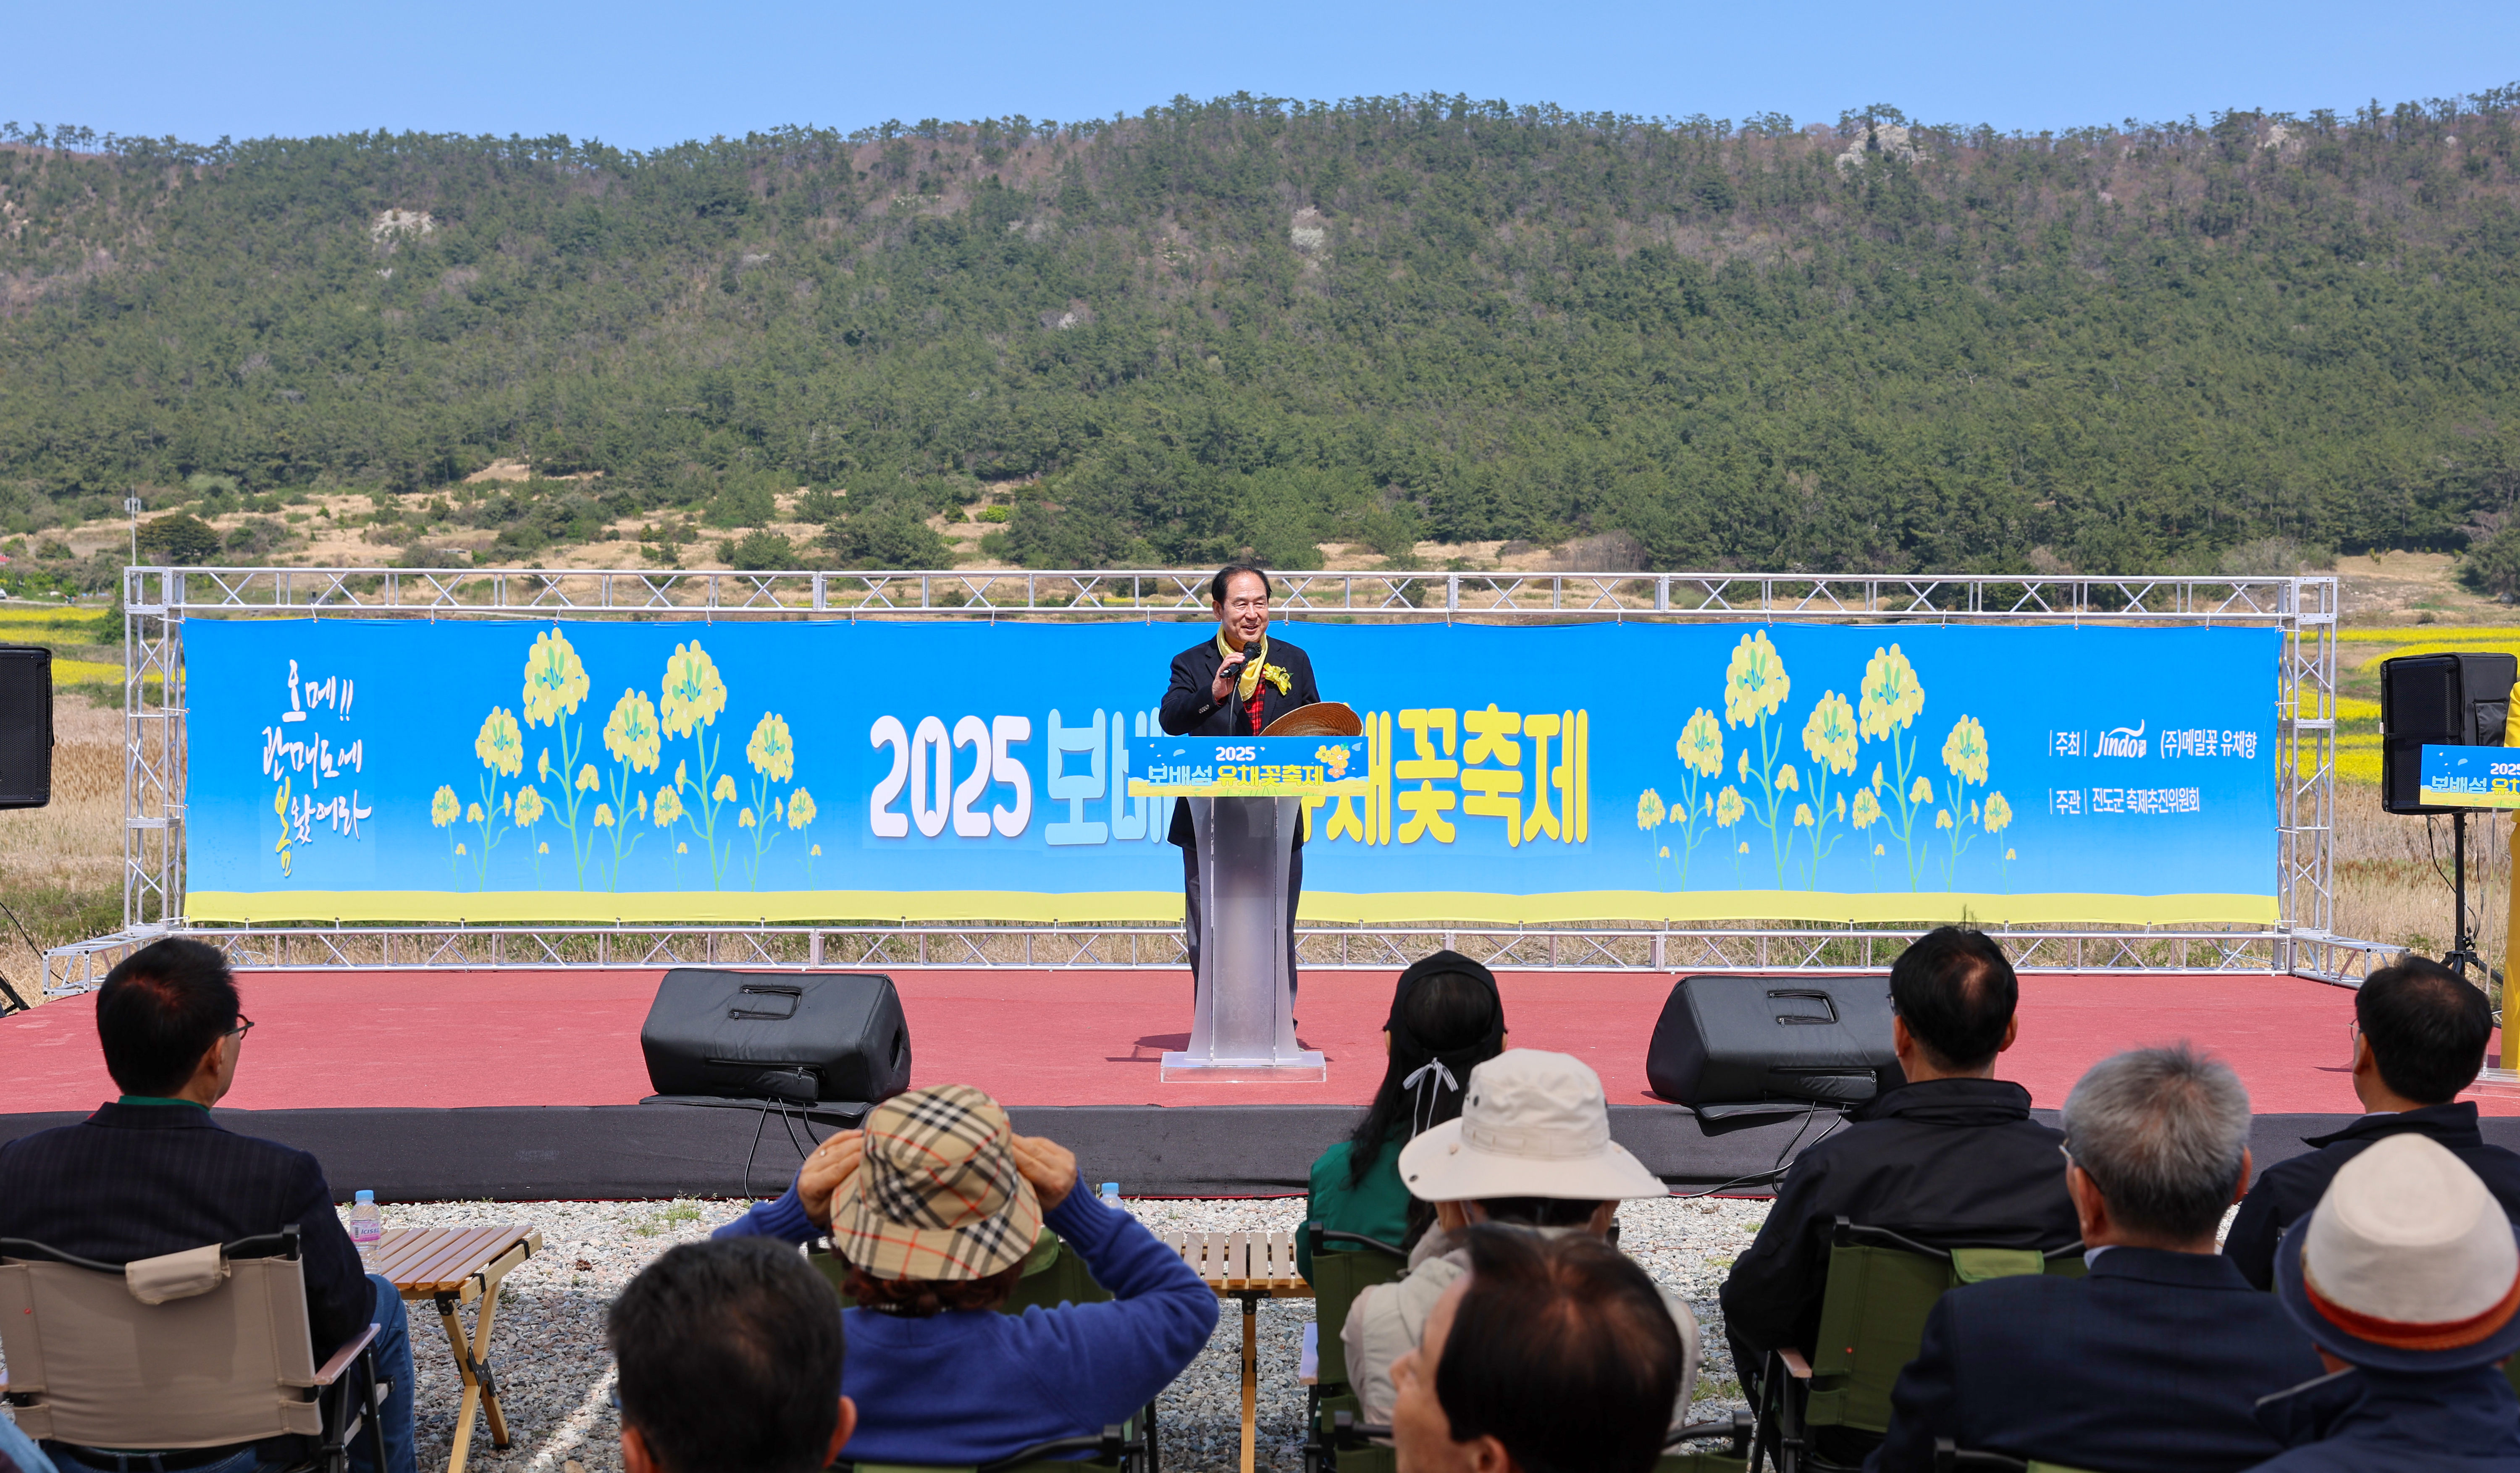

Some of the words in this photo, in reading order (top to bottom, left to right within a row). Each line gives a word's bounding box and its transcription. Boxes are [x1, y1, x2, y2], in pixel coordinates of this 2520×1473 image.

[282, 659, 353, 722] 오메!!
[262, 726, 362, 789] 관매도에
[1216, 747, 1255, 761] 2025
[2056, 731, 2079, 756] 주최
[2093, 731, 2138, 757] Jindo
[2161, 729, 2218, 759] (주)메밀꽃
[2221, 730, 2257, 759] 유채향
[870, 715, 1032, 837] 2025
[1045, 707, 1174, 845] 보배
[1303, 703, 1588, 847] 채꽃축제
[1147, 765, 1213, 786] 보배섬
[1217, 765, 1323, 786] 유채꽃축제
[2431, 776, 2487, 794] 보배섬
[2056, 790, 2080, 815] 주관
[2092, 788, 2124, 813] 진도군
[2127, 787, 2200, 814] 축제추진위원회
